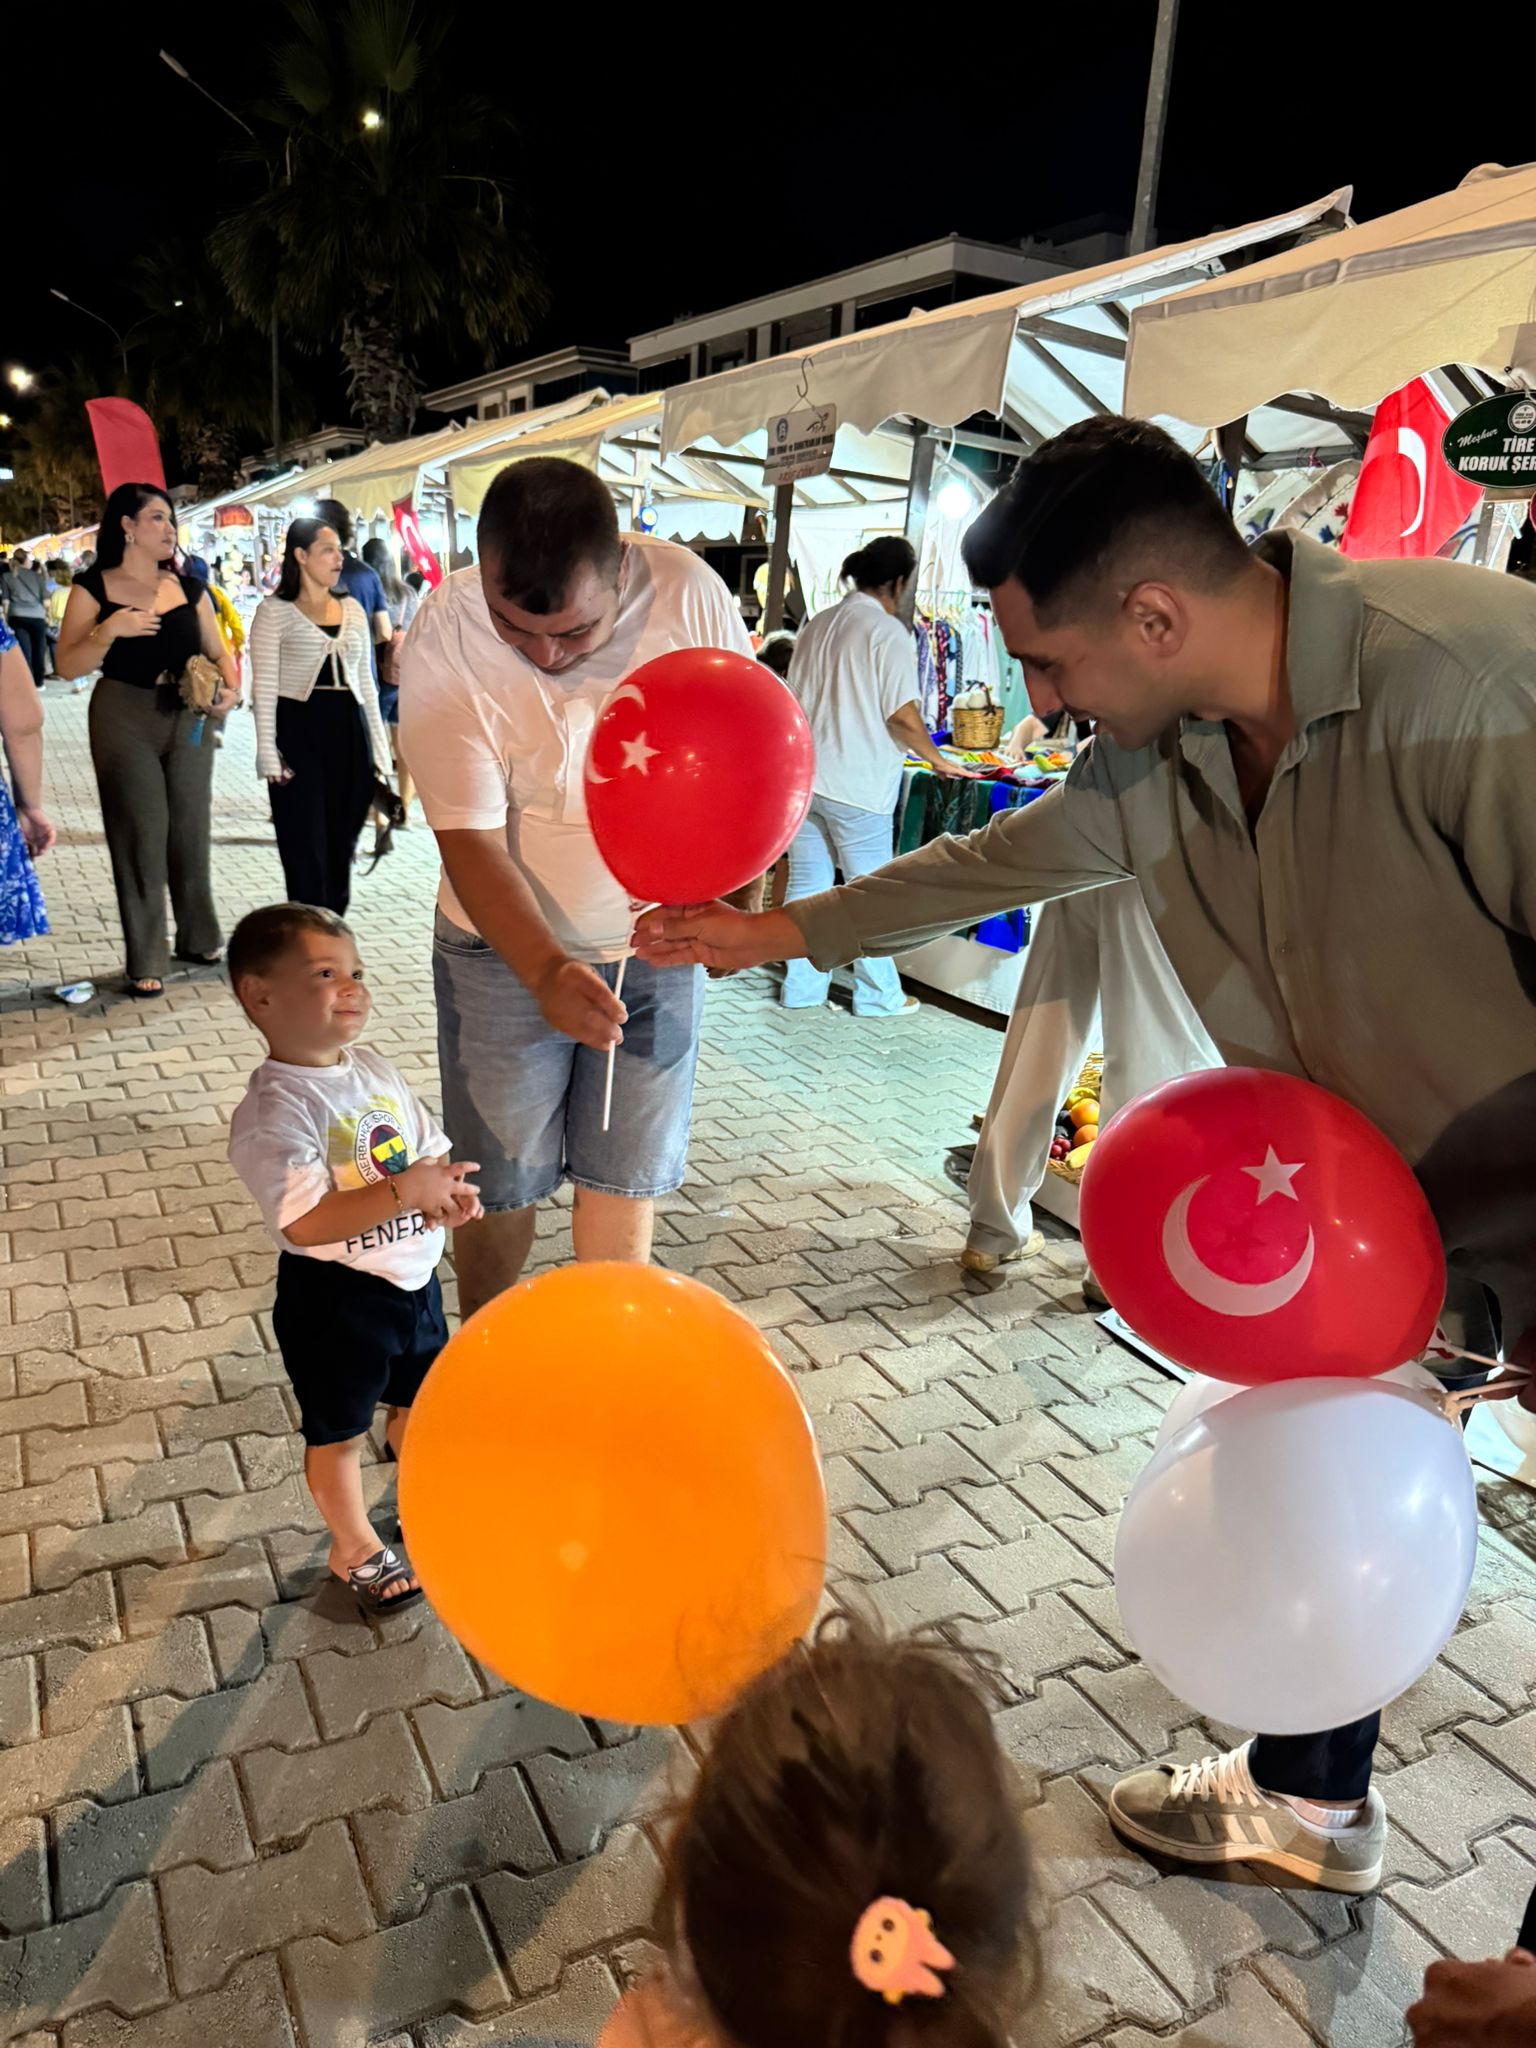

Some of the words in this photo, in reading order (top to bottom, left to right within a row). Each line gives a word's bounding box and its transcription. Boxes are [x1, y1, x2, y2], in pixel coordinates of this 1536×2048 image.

[1457, 428, 1498, 448] Meşhur
[1502, 435, 1536, 453] TİRE
[1458, 455, 1510, 471] KORUK
[358, 1119, 379, 1183] ENERBAHÇE
